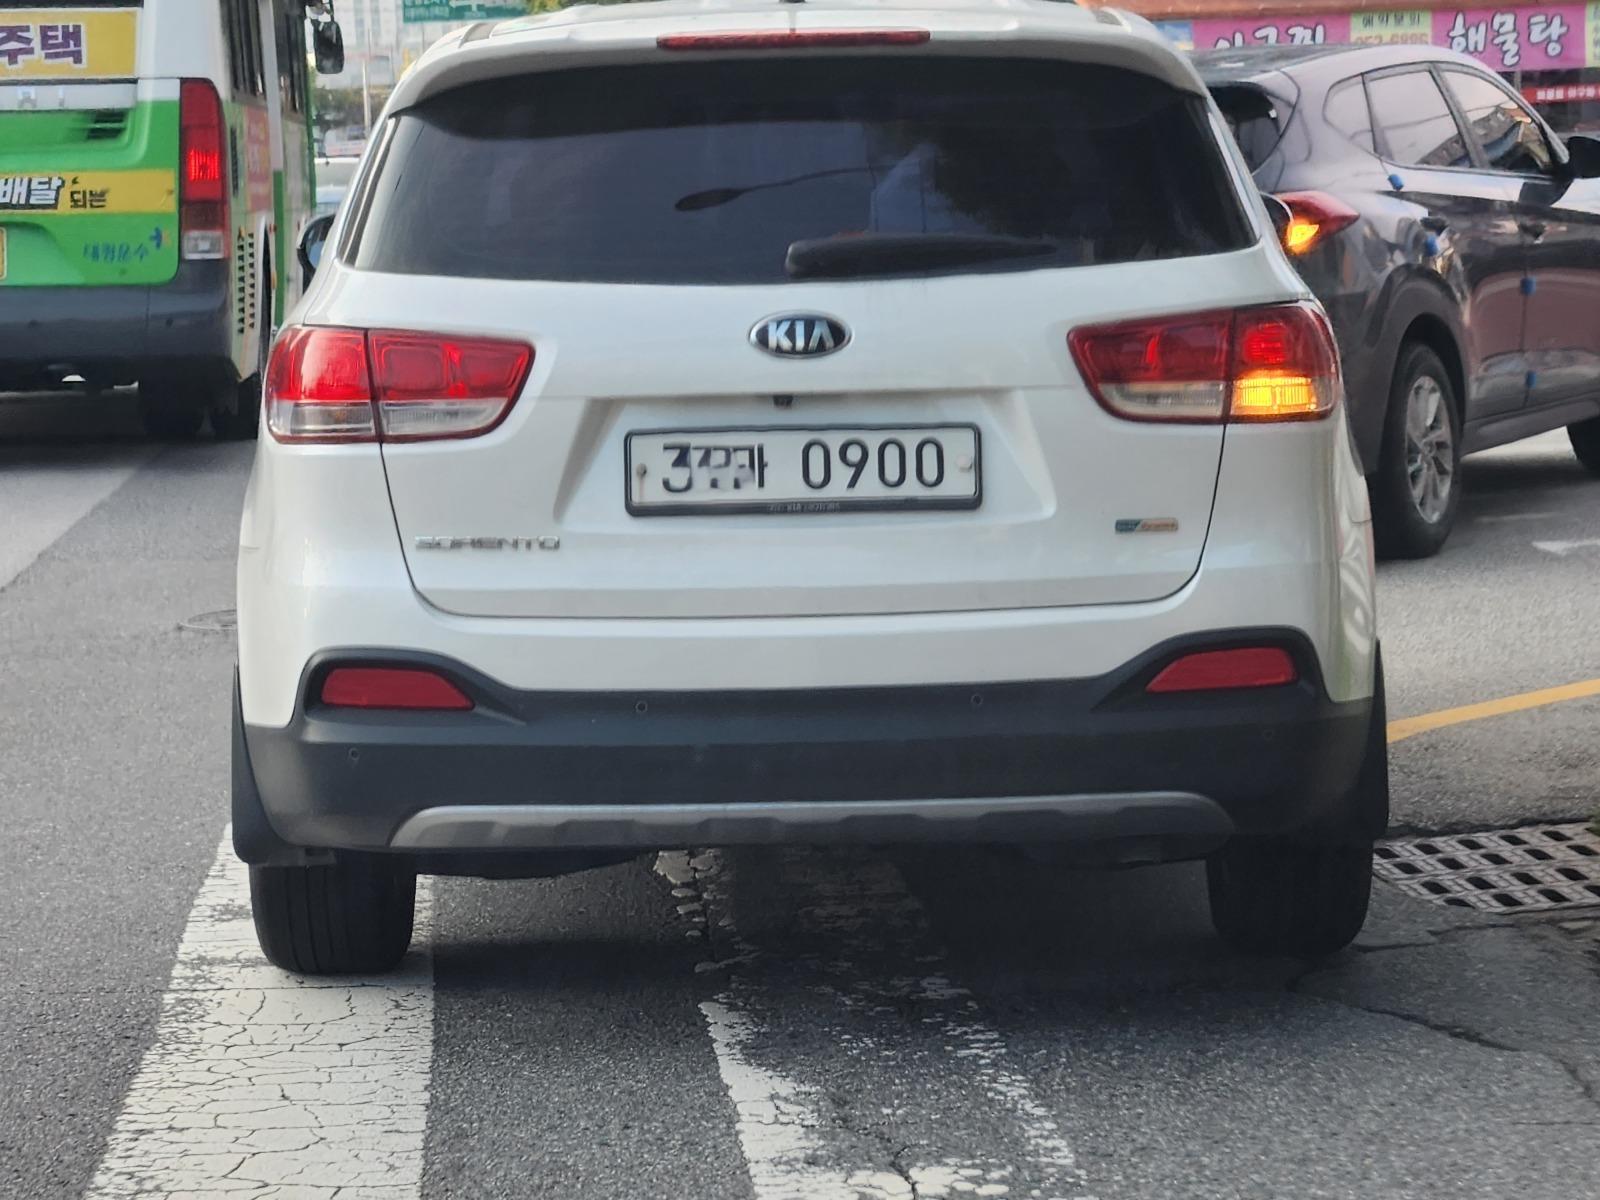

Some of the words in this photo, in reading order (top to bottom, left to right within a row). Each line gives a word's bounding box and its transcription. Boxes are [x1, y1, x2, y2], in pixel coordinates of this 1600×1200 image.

[0, 24, 83, 66] 주택
[1449, 12, 1569, 67] 해물탕
[0, 176, 65, 210] 배달
[767, 319, 835, 353] KIA
[801, 437, 945, 490] 0900
[415, 535, 560, 551] SORENTO
